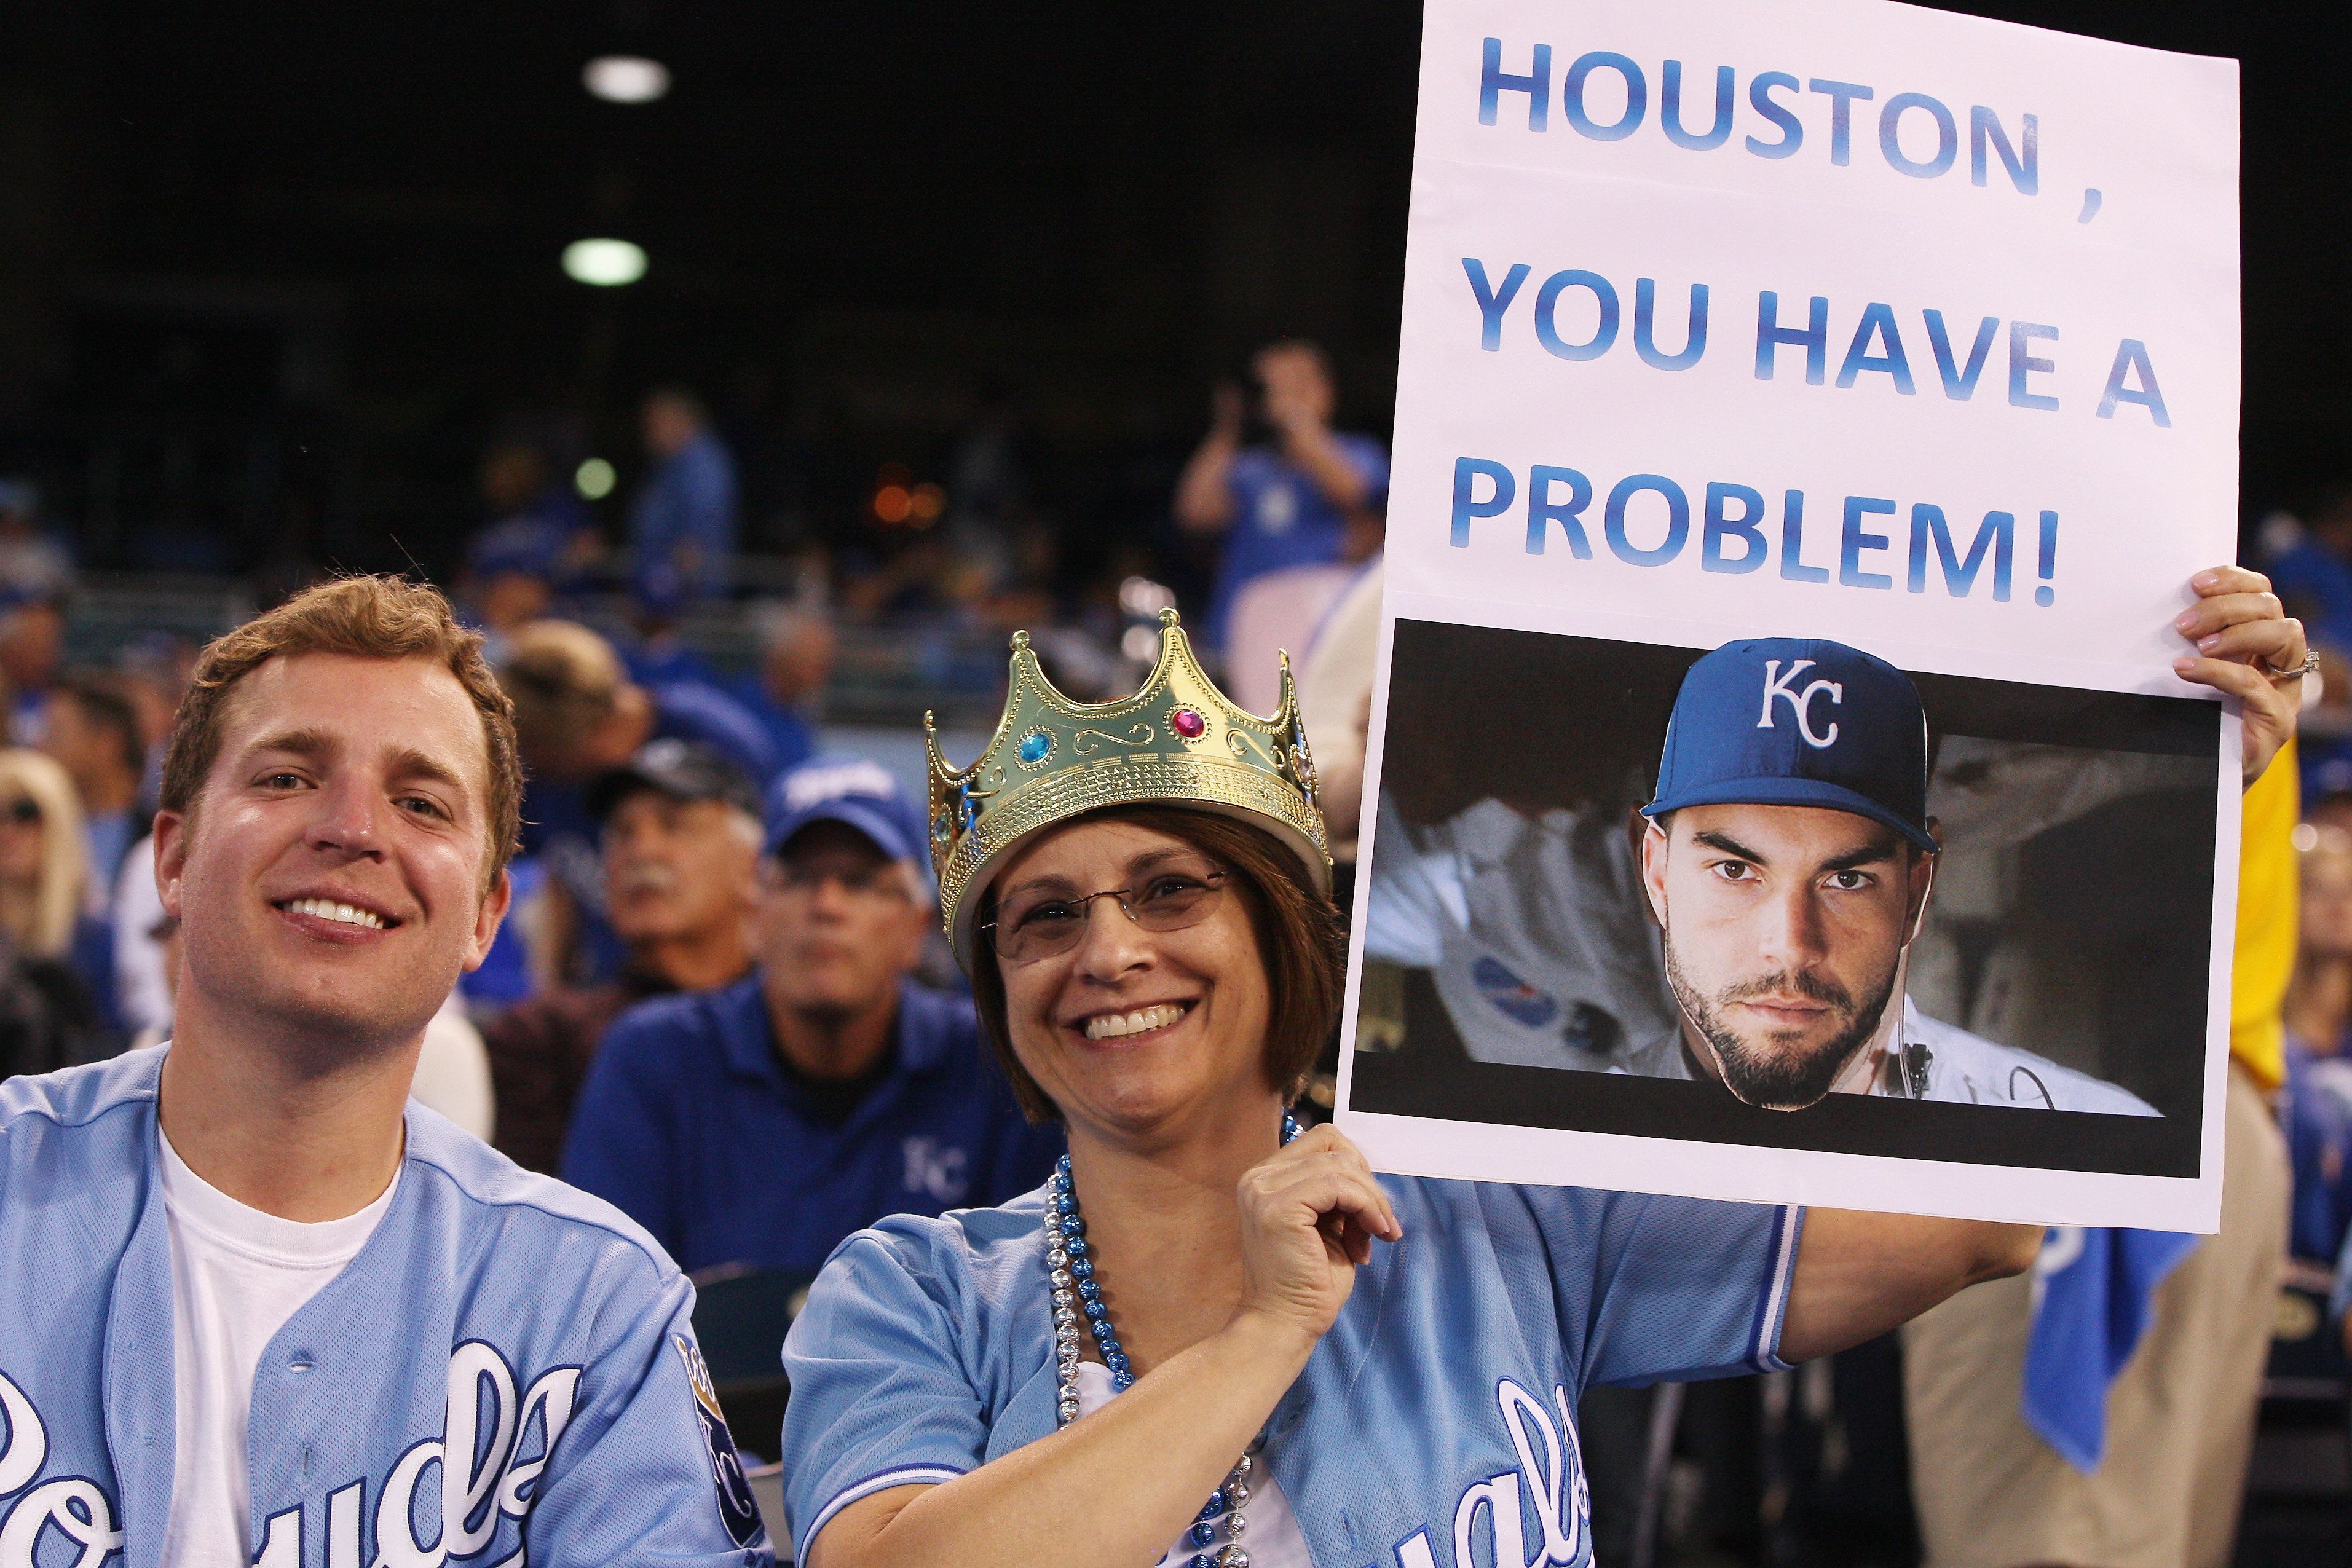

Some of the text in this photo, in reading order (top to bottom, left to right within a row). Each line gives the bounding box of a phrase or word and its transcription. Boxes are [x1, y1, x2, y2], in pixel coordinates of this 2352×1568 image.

[1478, 36, 2040, 195] HOUSTON
[1461, 256, 2172, 428] YOU HAVE A
[1449, 456, 2059, 608] PROBLEM!
[1756, 659, 1842, 749] KC
